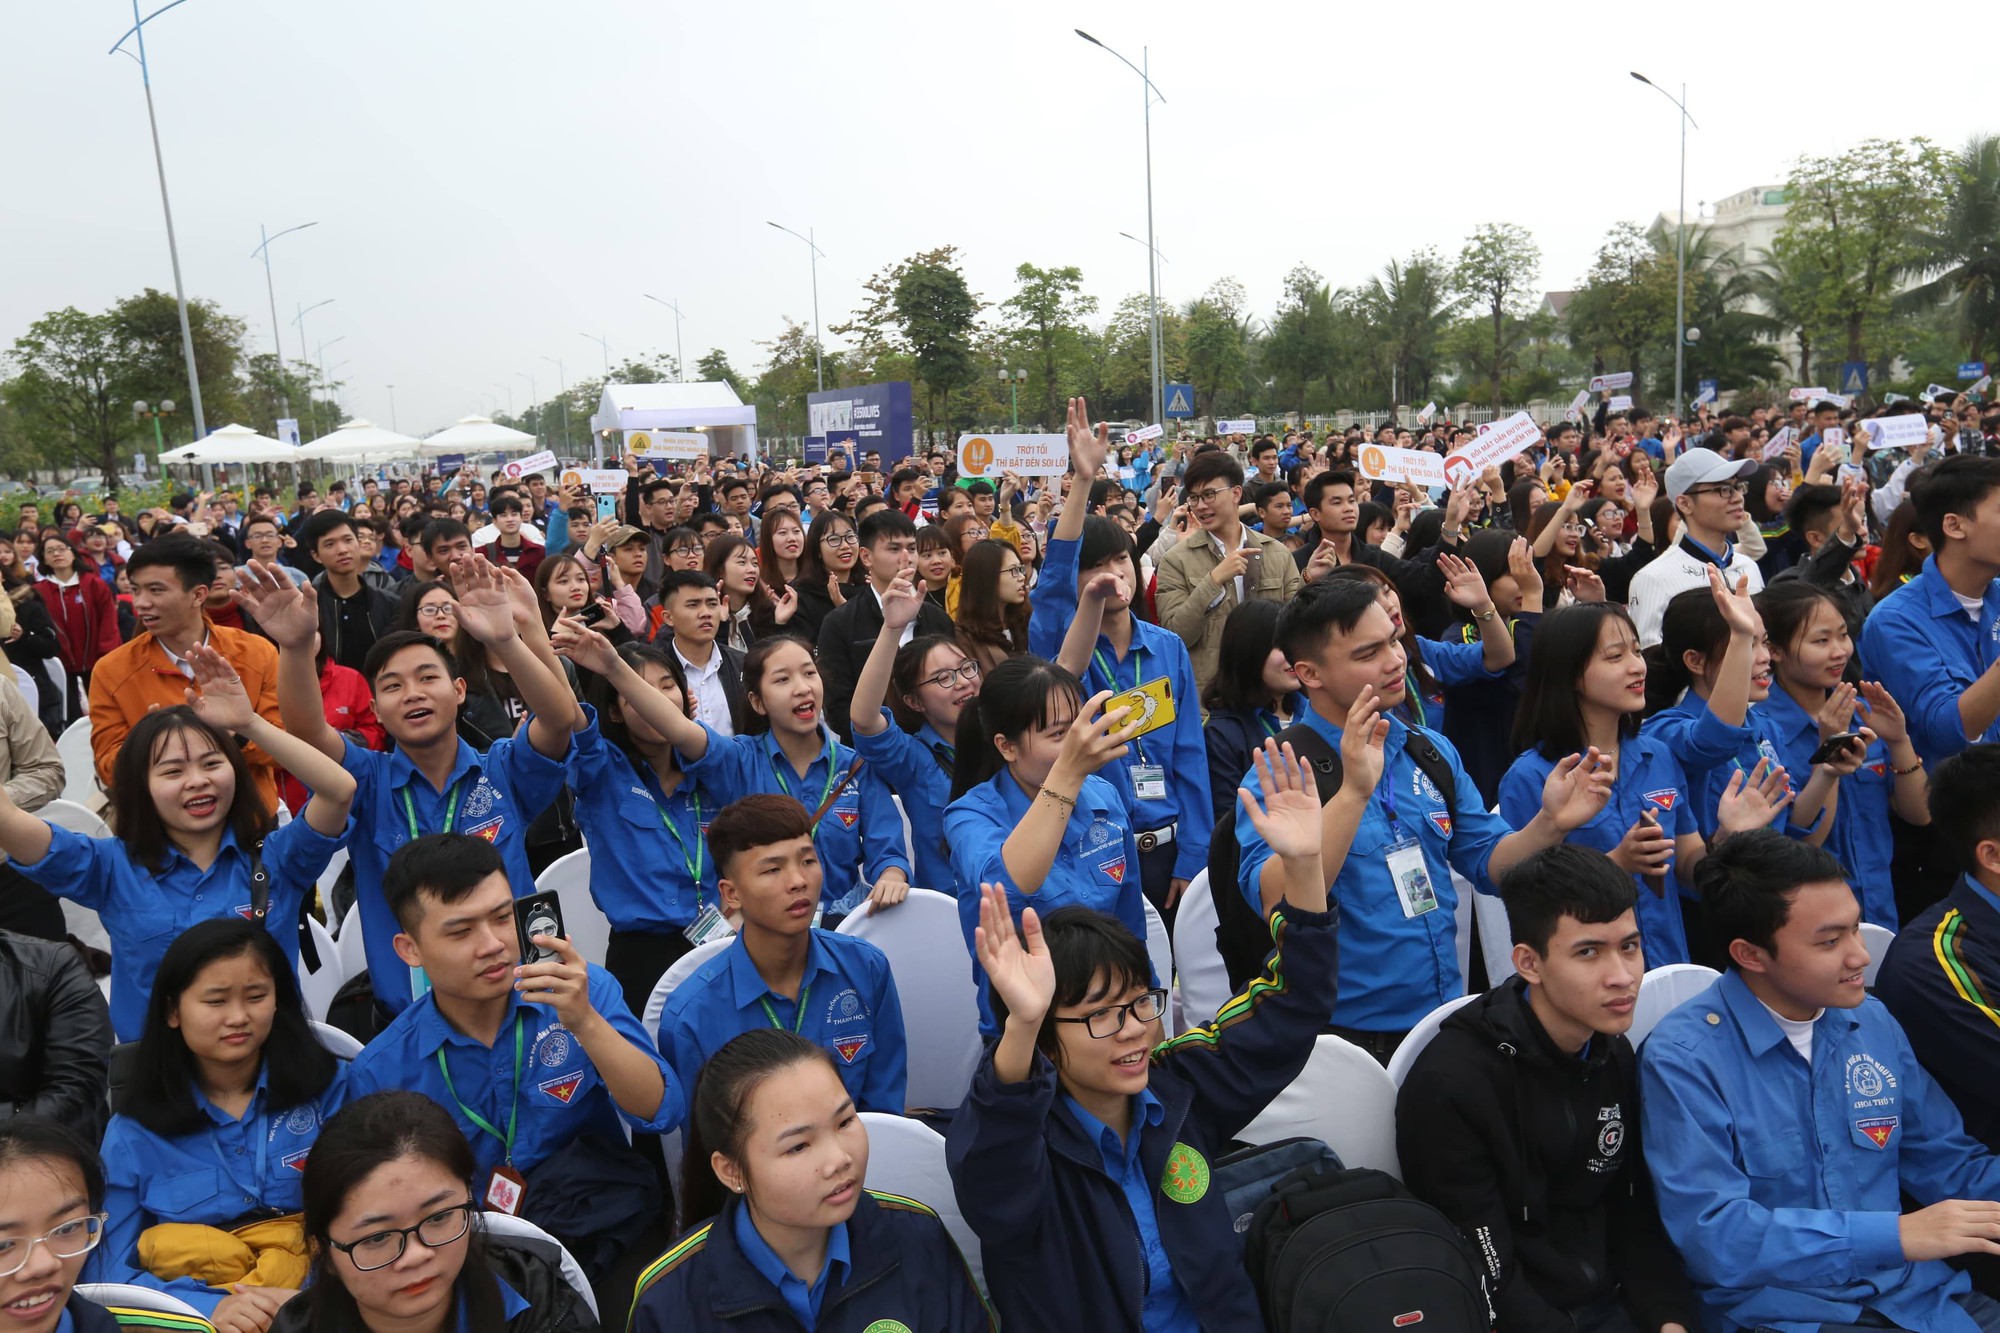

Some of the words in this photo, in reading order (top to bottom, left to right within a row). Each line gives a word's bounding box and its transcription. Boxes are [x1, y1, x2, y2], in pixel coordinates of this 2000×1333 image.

[1525, 426, 1537, 438] TRA
[1016, 445, 1035, 454] TRỜI
[1037, 443, 1048, 454] TỐI
[996, 457, 1007, 467] THÌ
[1009, 458, 1023, 469] BẬT
[1025, 457, 1041, 467] ĐÈN
[1041, 459, 1054, 467] SOI
[1055, 456, 1067, 467] LỐI
[833, 1017, 853, 1025] THANH
[1874, 1061, 1897, 1088] NGUYỆN
[1889, 1097, 1895, 1105] Y
[1476, 1228, 1490, 1255] PISTON
